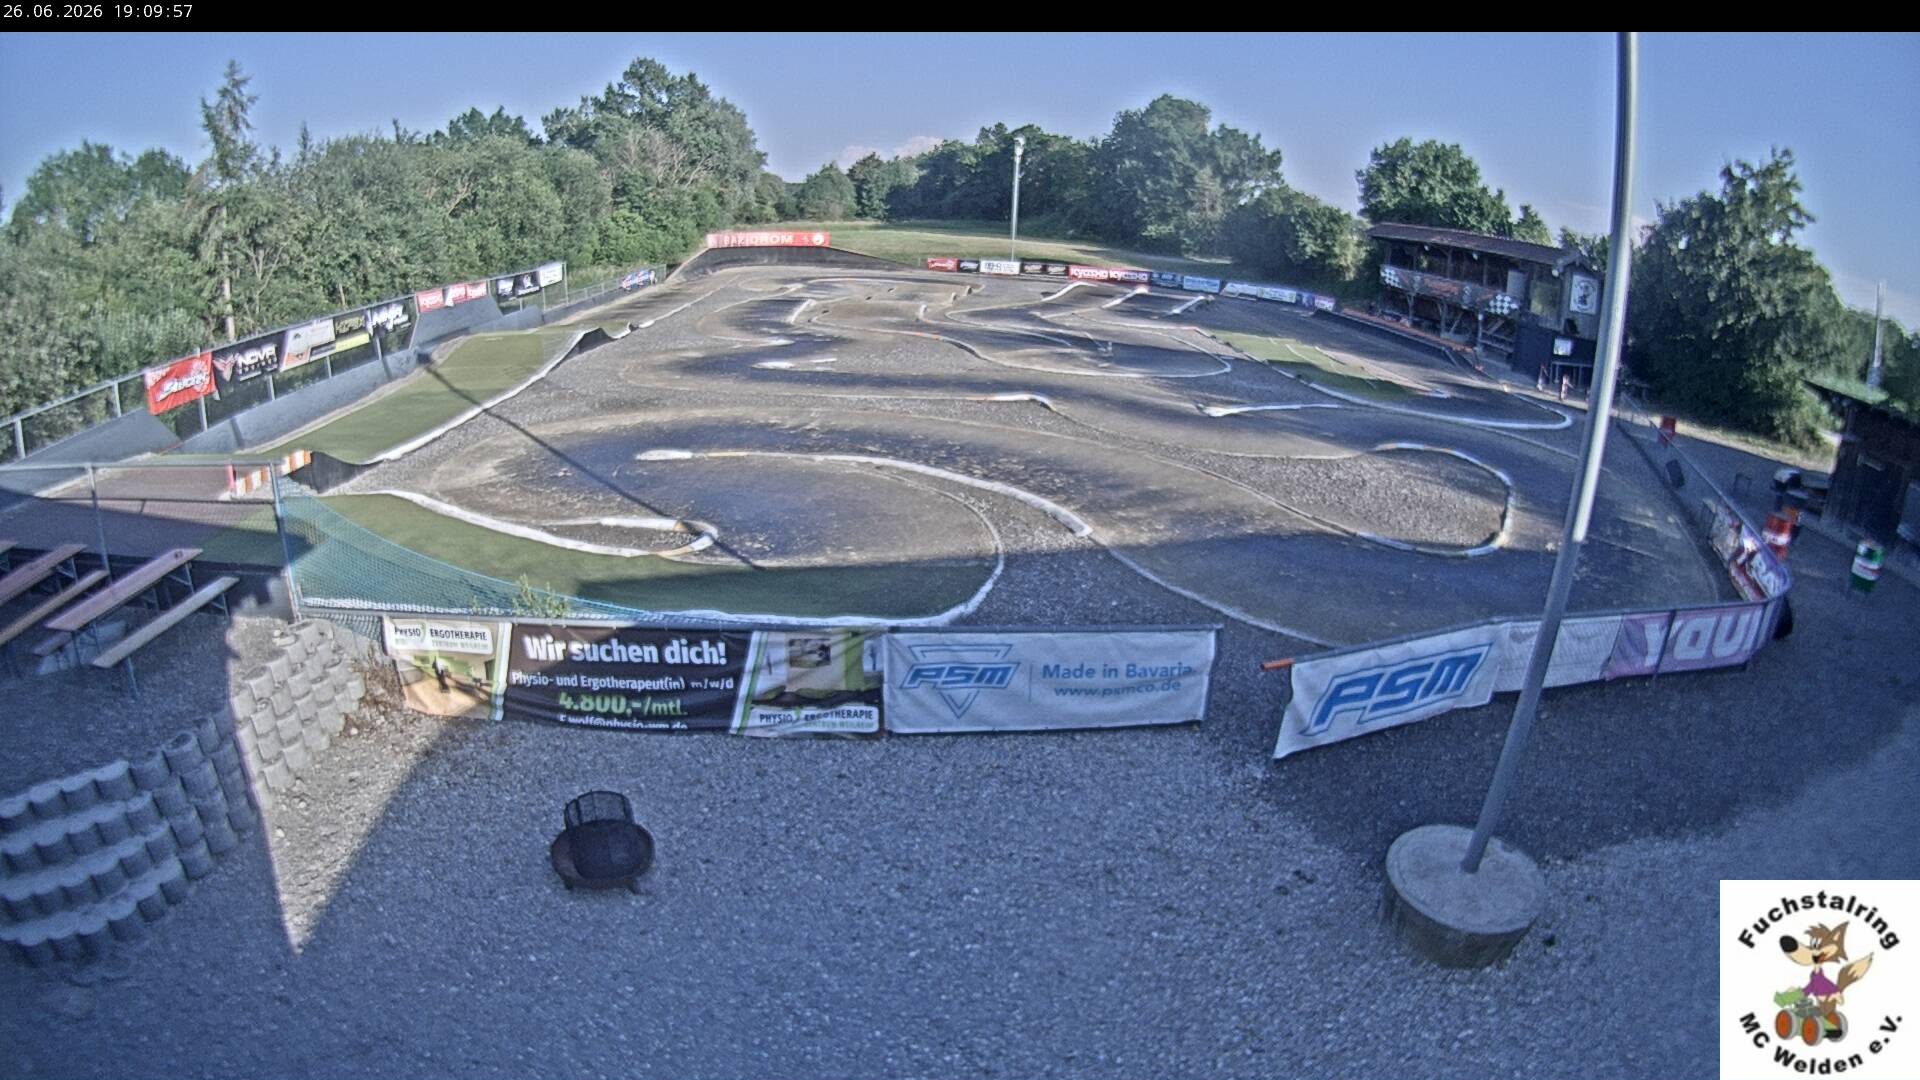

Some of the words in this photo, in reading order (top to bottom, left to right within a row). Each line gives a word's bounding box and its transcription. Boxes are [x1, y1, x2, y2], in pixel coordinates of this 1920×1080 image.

[395, 626, 421, 636] PHYSIO
[430, 628, 487, 640] ERGOTHERAPIE
[523, 633, 567, 661] Wir
[569, 636, 658, 663] suchen
[664, 637, 728, 665] dich!
[904, 664, 1016, 687] PSM
[1042, 663, 1096, 680] Made
[1102, 663, 1123, 679] in
[1126, 661, 1193, 679] Bavaria
[511, 671, 554, 687] Physio-
[556, 674, 578, 687] und
[580, 675, 685, 692] Ergotherapeut(in)
[690, 677, 734, 690] m/w/d
[1308, 650, 1486, 731] PSM
[759, 713, 793, 724] PHYSIO
